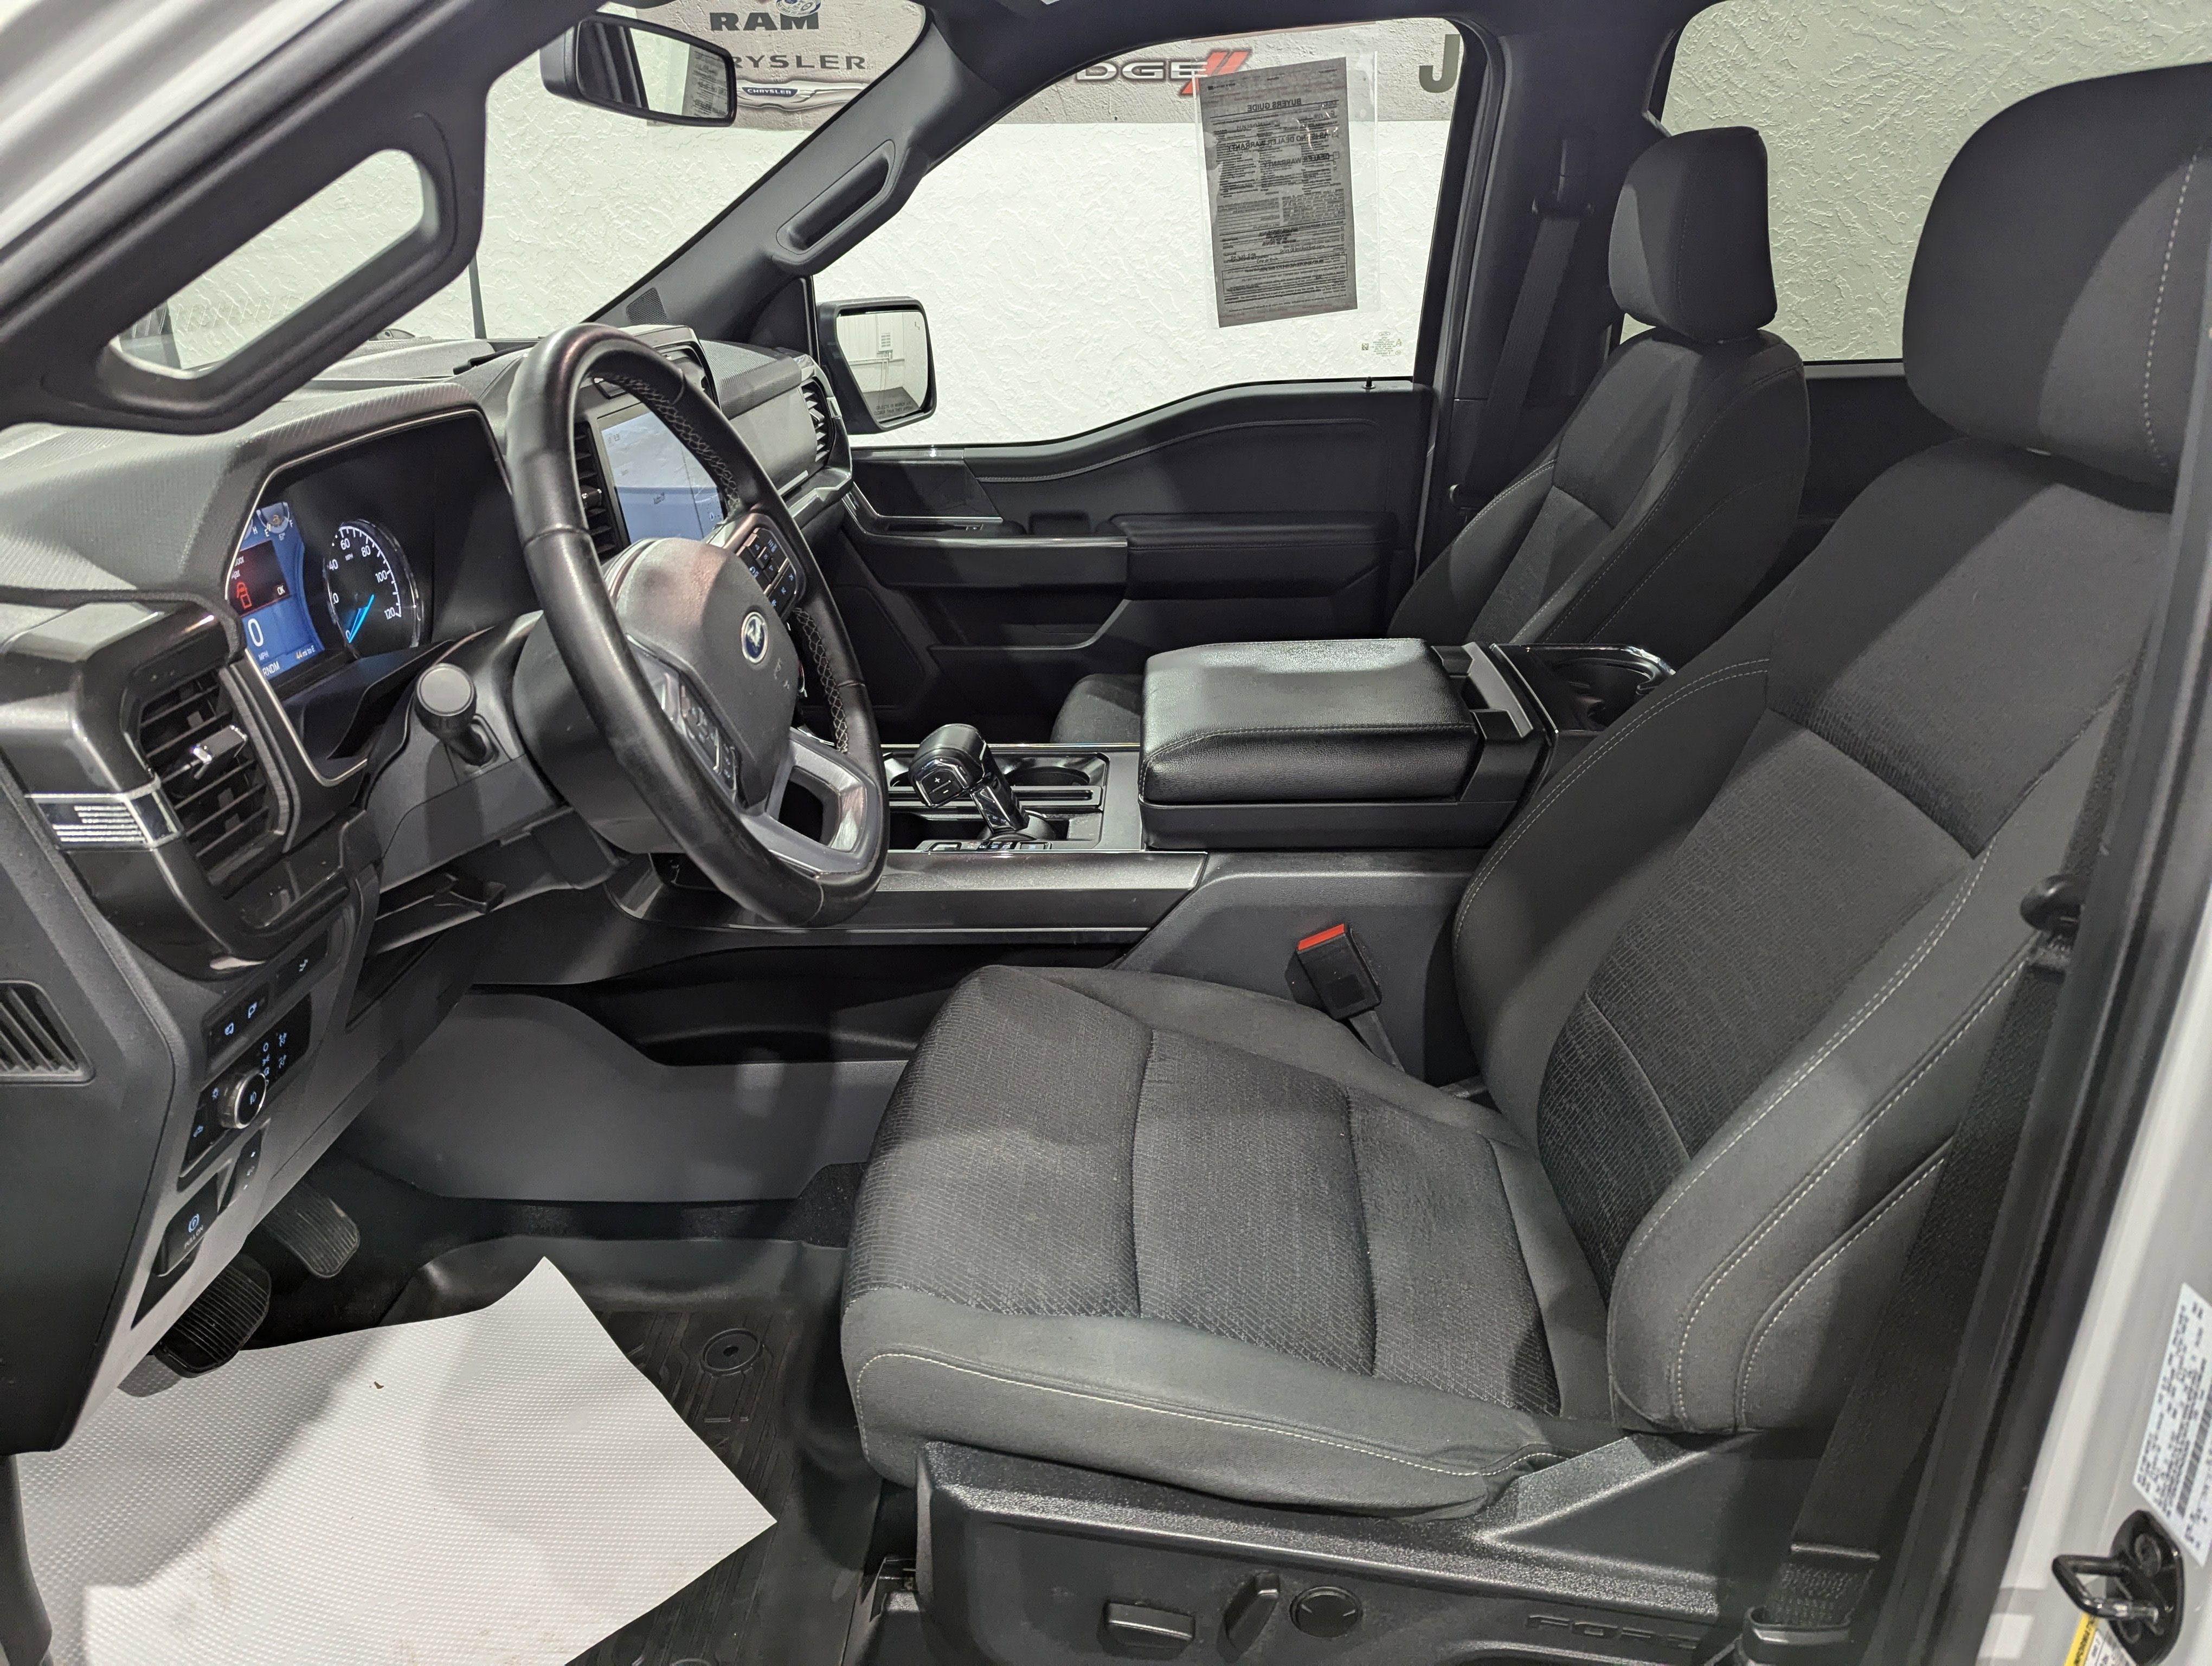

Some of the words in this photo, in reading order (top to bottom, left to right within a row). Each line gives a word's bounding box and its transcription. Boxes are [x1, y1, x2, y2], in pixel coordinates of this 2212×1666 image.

[709, 12, 819, 31] RAM
[252, 526, 258, 535] H
[340, 537, 350, 550] 60
[361, 545, 371, 558] 80
[329, 559, 339, 571] 40
[375, 569, 388, 583] 100
[277, 585, 286, 596] OK
[384, 606, 396, 620] 120
[248, 618, 263, 647] 0
[258, 650, 269, 661] MPH
